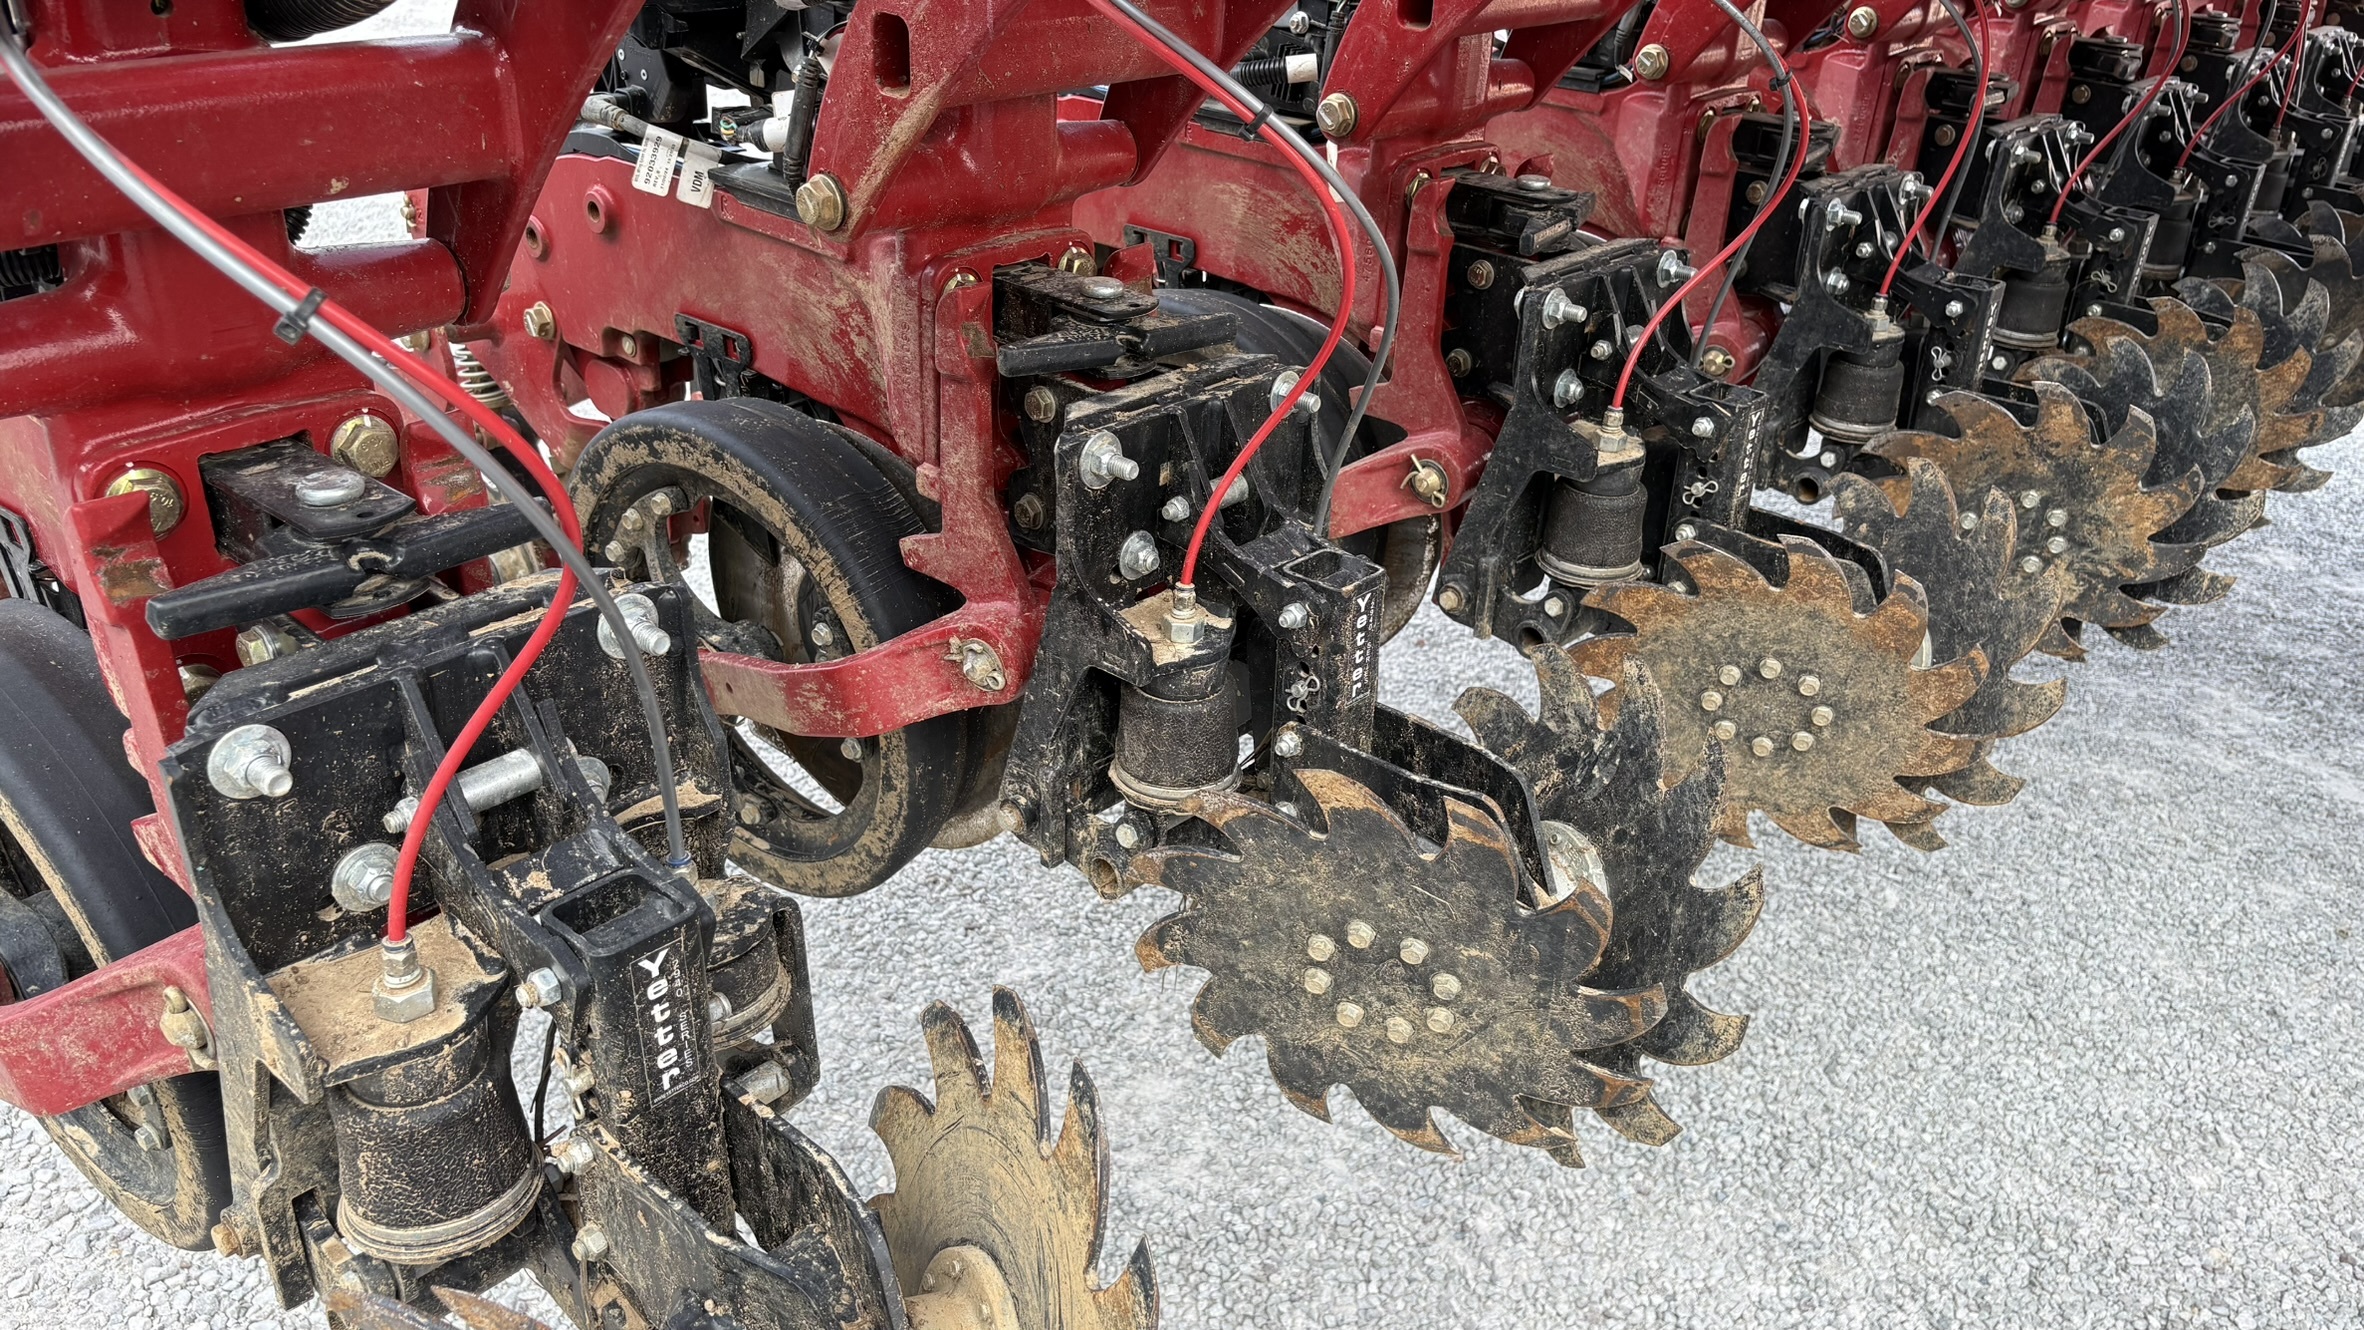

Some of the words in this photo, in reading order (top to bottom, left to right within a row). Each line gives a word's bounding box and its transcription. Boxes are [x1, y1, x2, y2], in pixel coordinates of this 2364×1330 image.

[644, 135, 663, 185] 92033929
[691, 170, 704, 193] VDM
[1352, 592, 1373, 698] Yetter
[637, 948, 680, 1091] Yetter
[672, 958, 683, 998] 2940
[679, 1011, 694, 1069] SERIES
